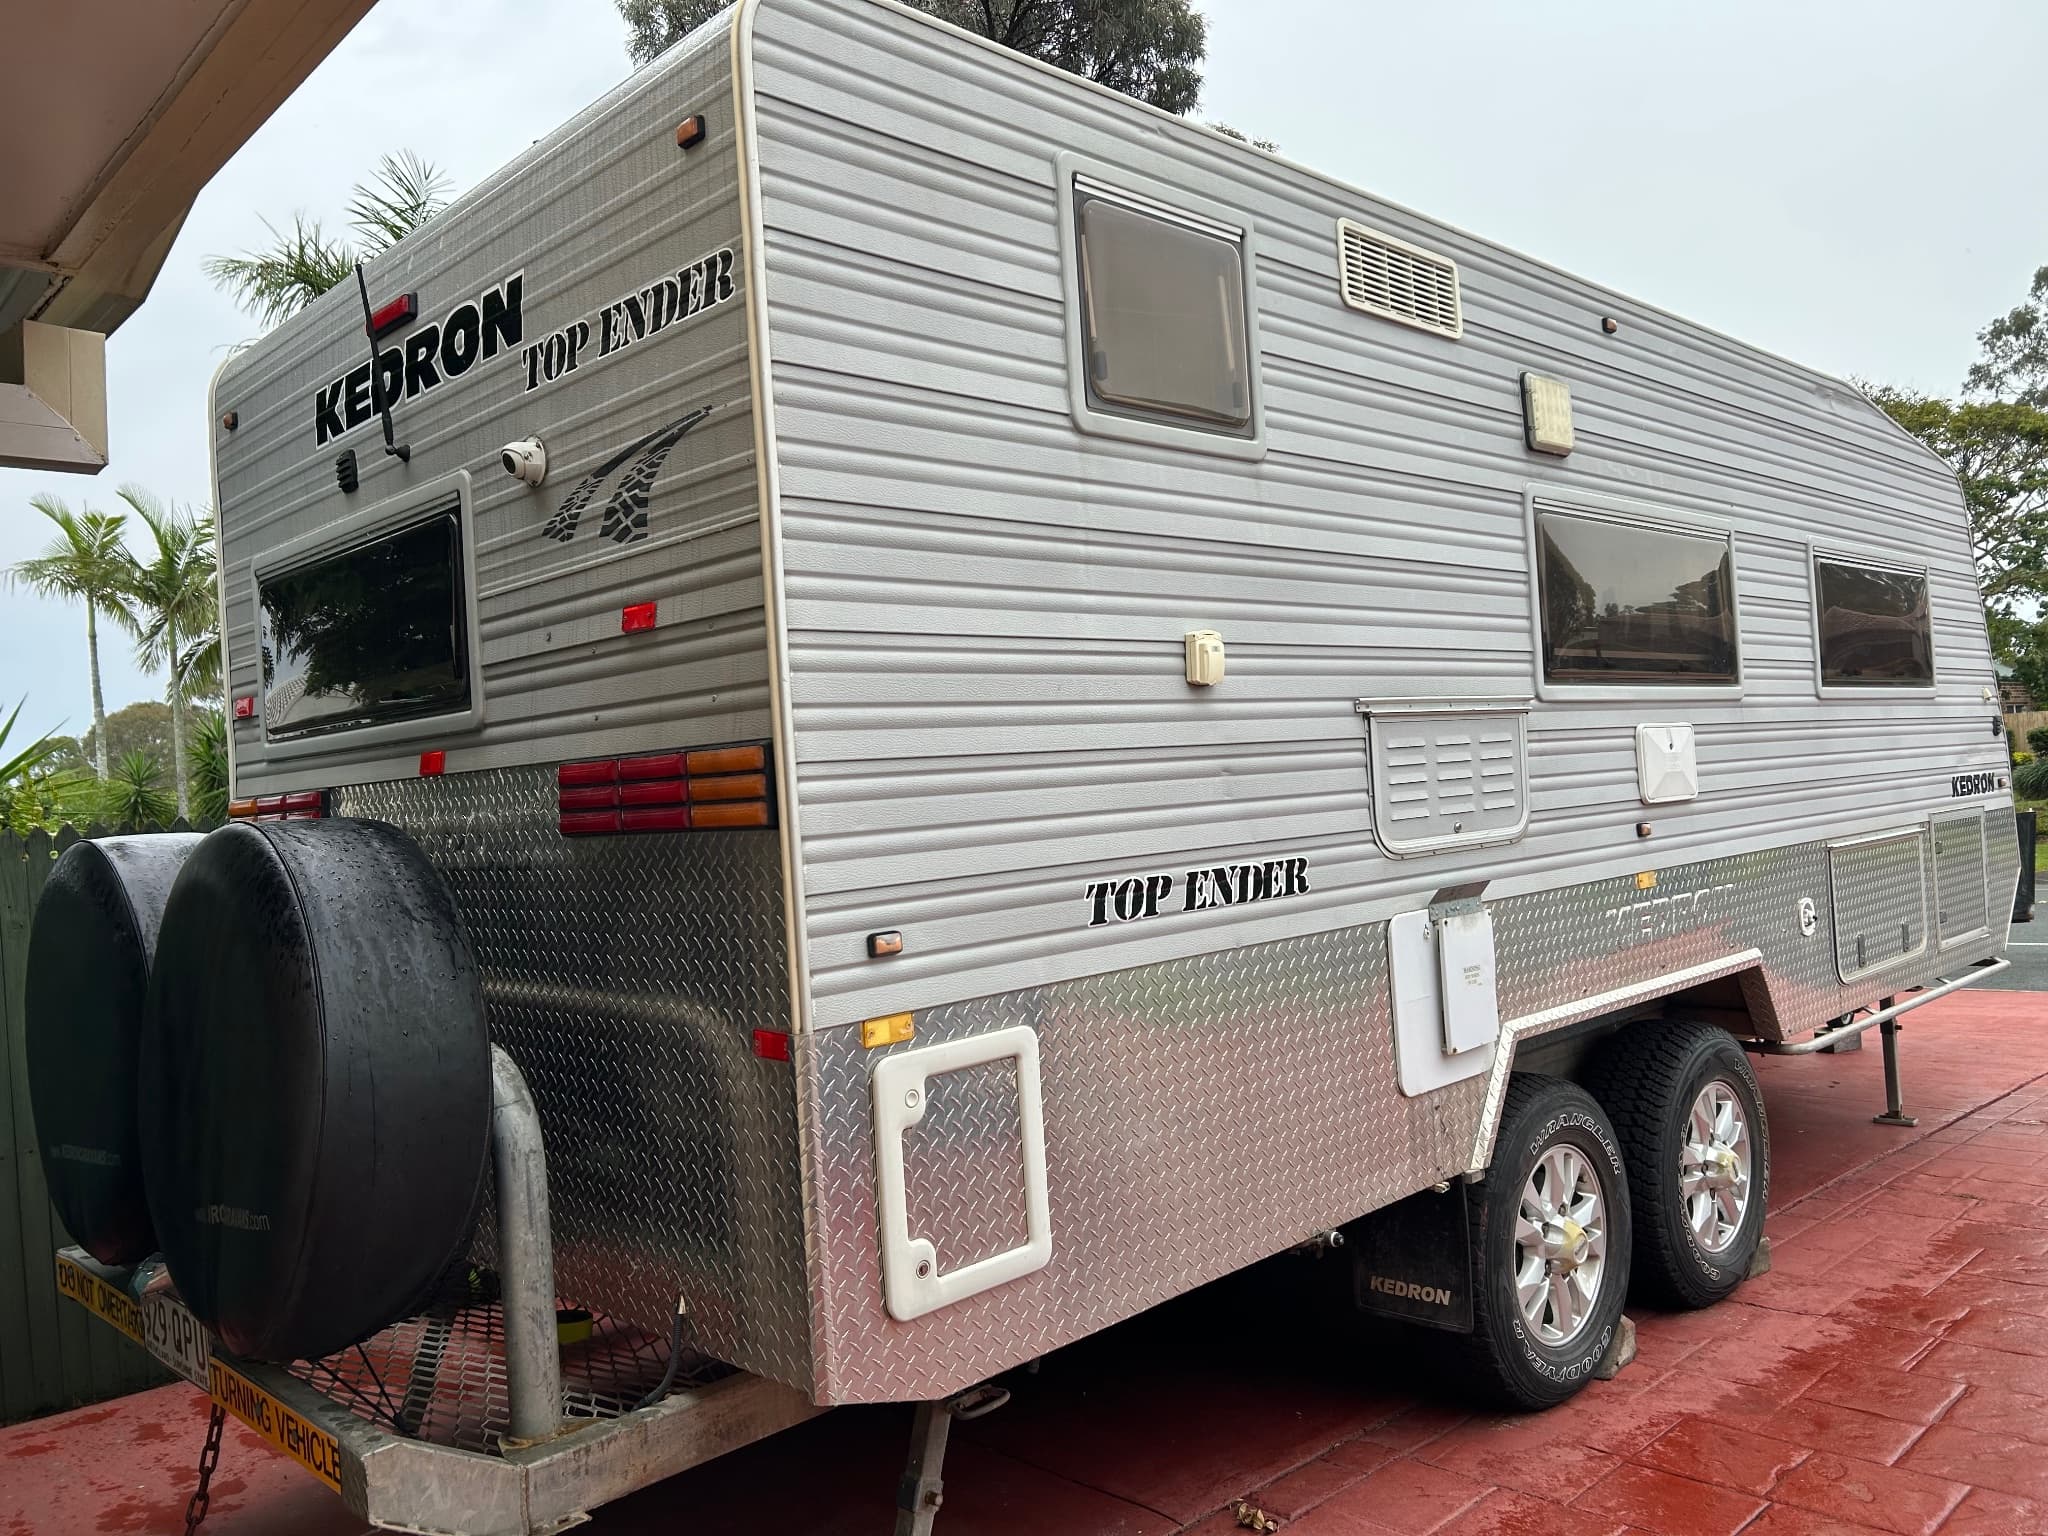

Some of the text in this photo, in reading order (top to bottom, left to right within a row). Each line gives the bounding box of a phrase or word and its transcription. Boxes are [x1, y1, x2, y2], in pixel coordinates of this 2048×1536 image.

[522, 248, 735, 393] TOP ENDER
[314, 269, 524, 449] KEDRON
[1951, 772, 1995, 797] KEDRON
[1085, 856, 1310, 927] TOP ENDER
[1530, 1112, 1621, 1175] WRANGLER
[59, 1263, 75, 1292] DO
[76, 1270, 94, 1302] NOT
[1370, 1275, 1451, 1306] KEDRON
[1513, 1319, 1612, 1382] GOODYEAR
[210, 1363, 342, 1485] TURNING VEHICLE
